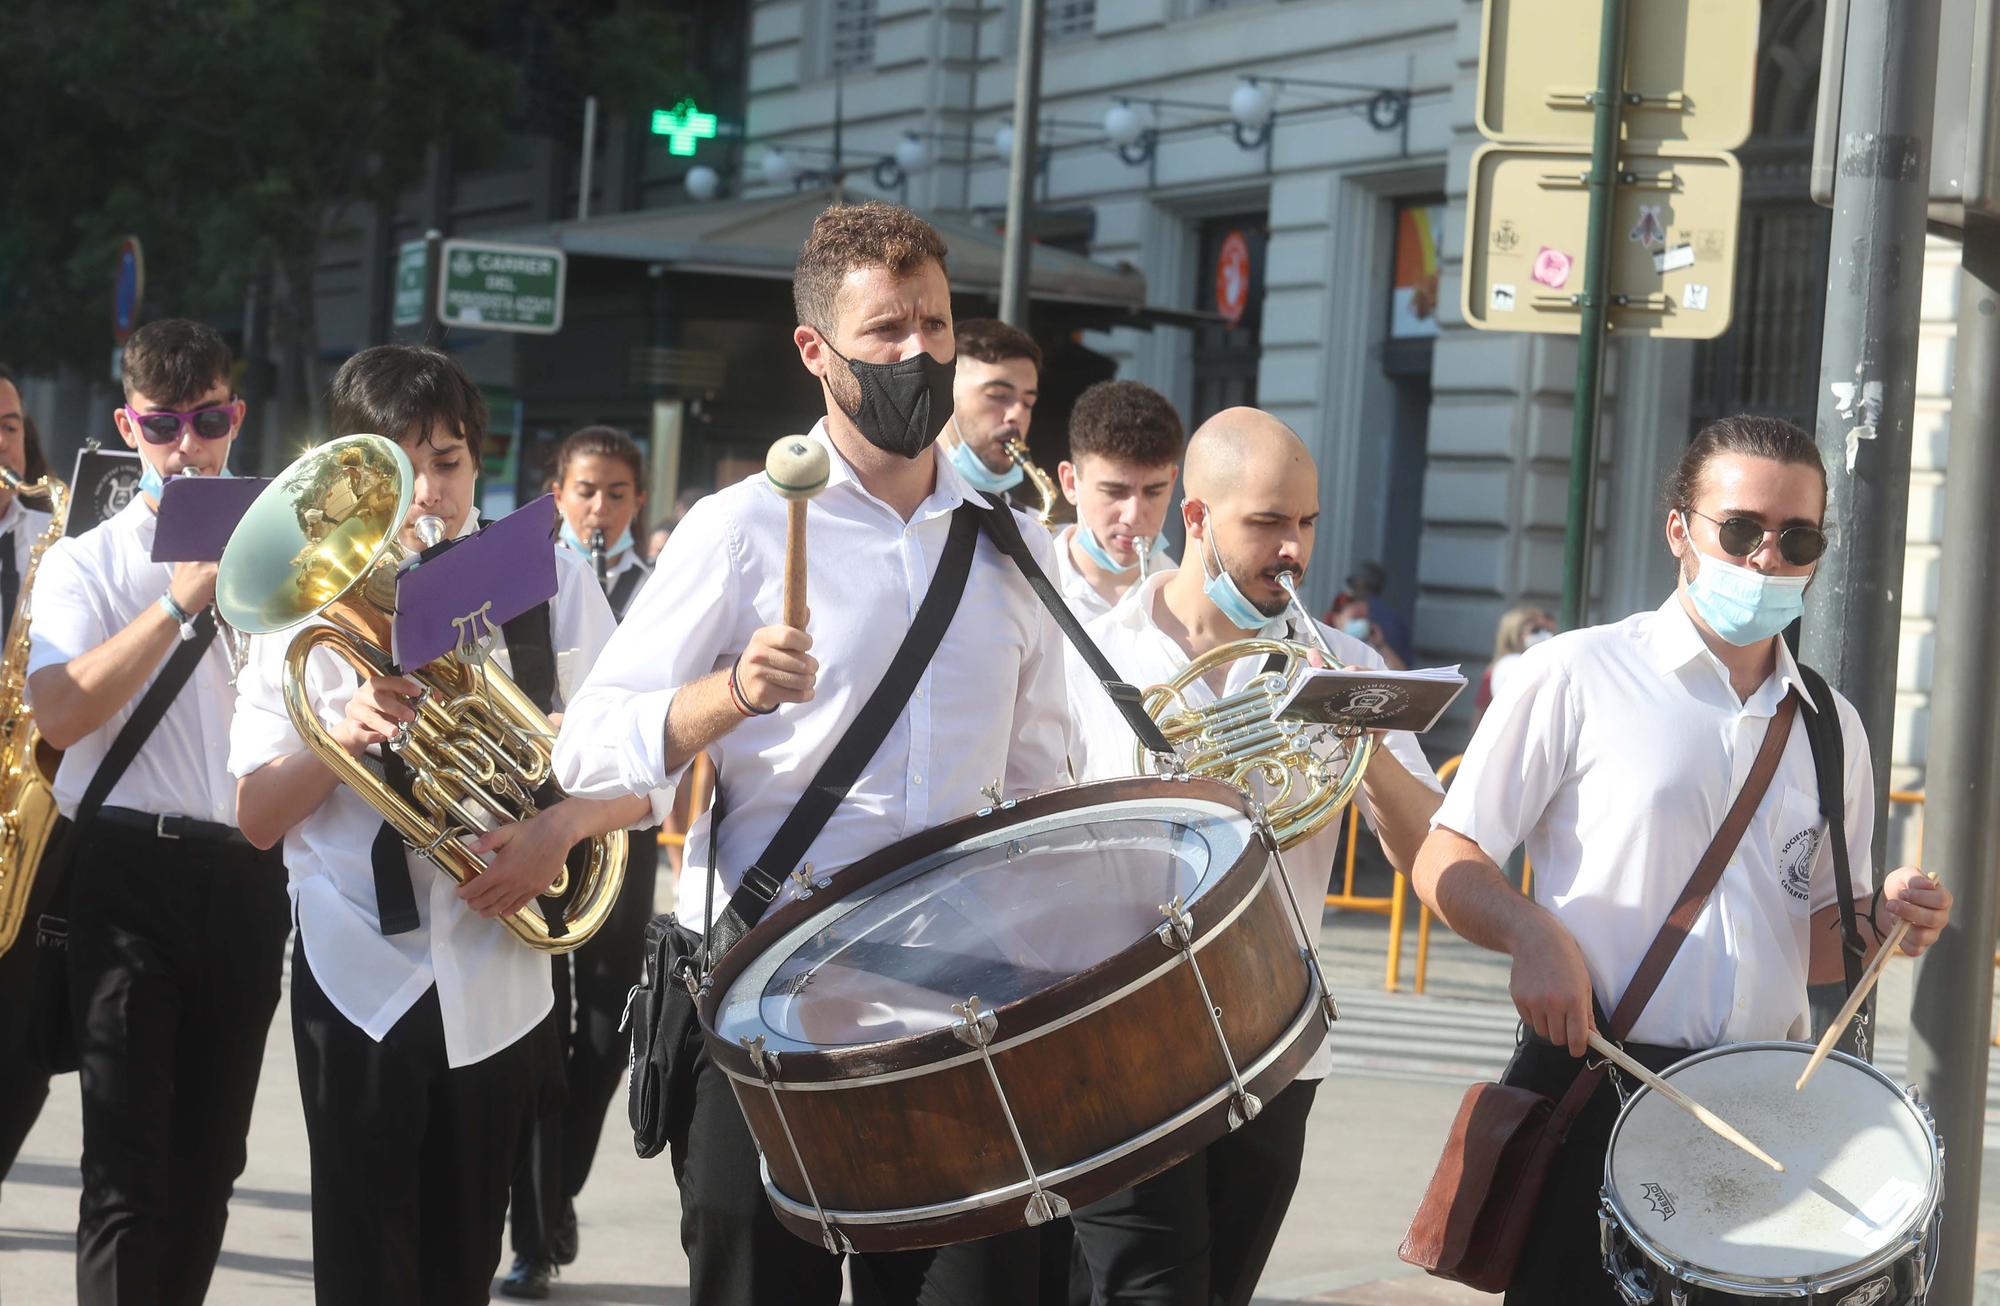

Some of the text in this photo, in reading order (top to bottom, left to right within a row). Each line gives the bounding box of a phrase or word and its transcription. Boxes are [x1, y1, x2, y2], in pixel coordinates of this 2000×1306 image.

[476, 254, 553, 276] CARRER
[484, 274, 517, 293] DEL
[1650, 1185, 1673, 1214] REMO
